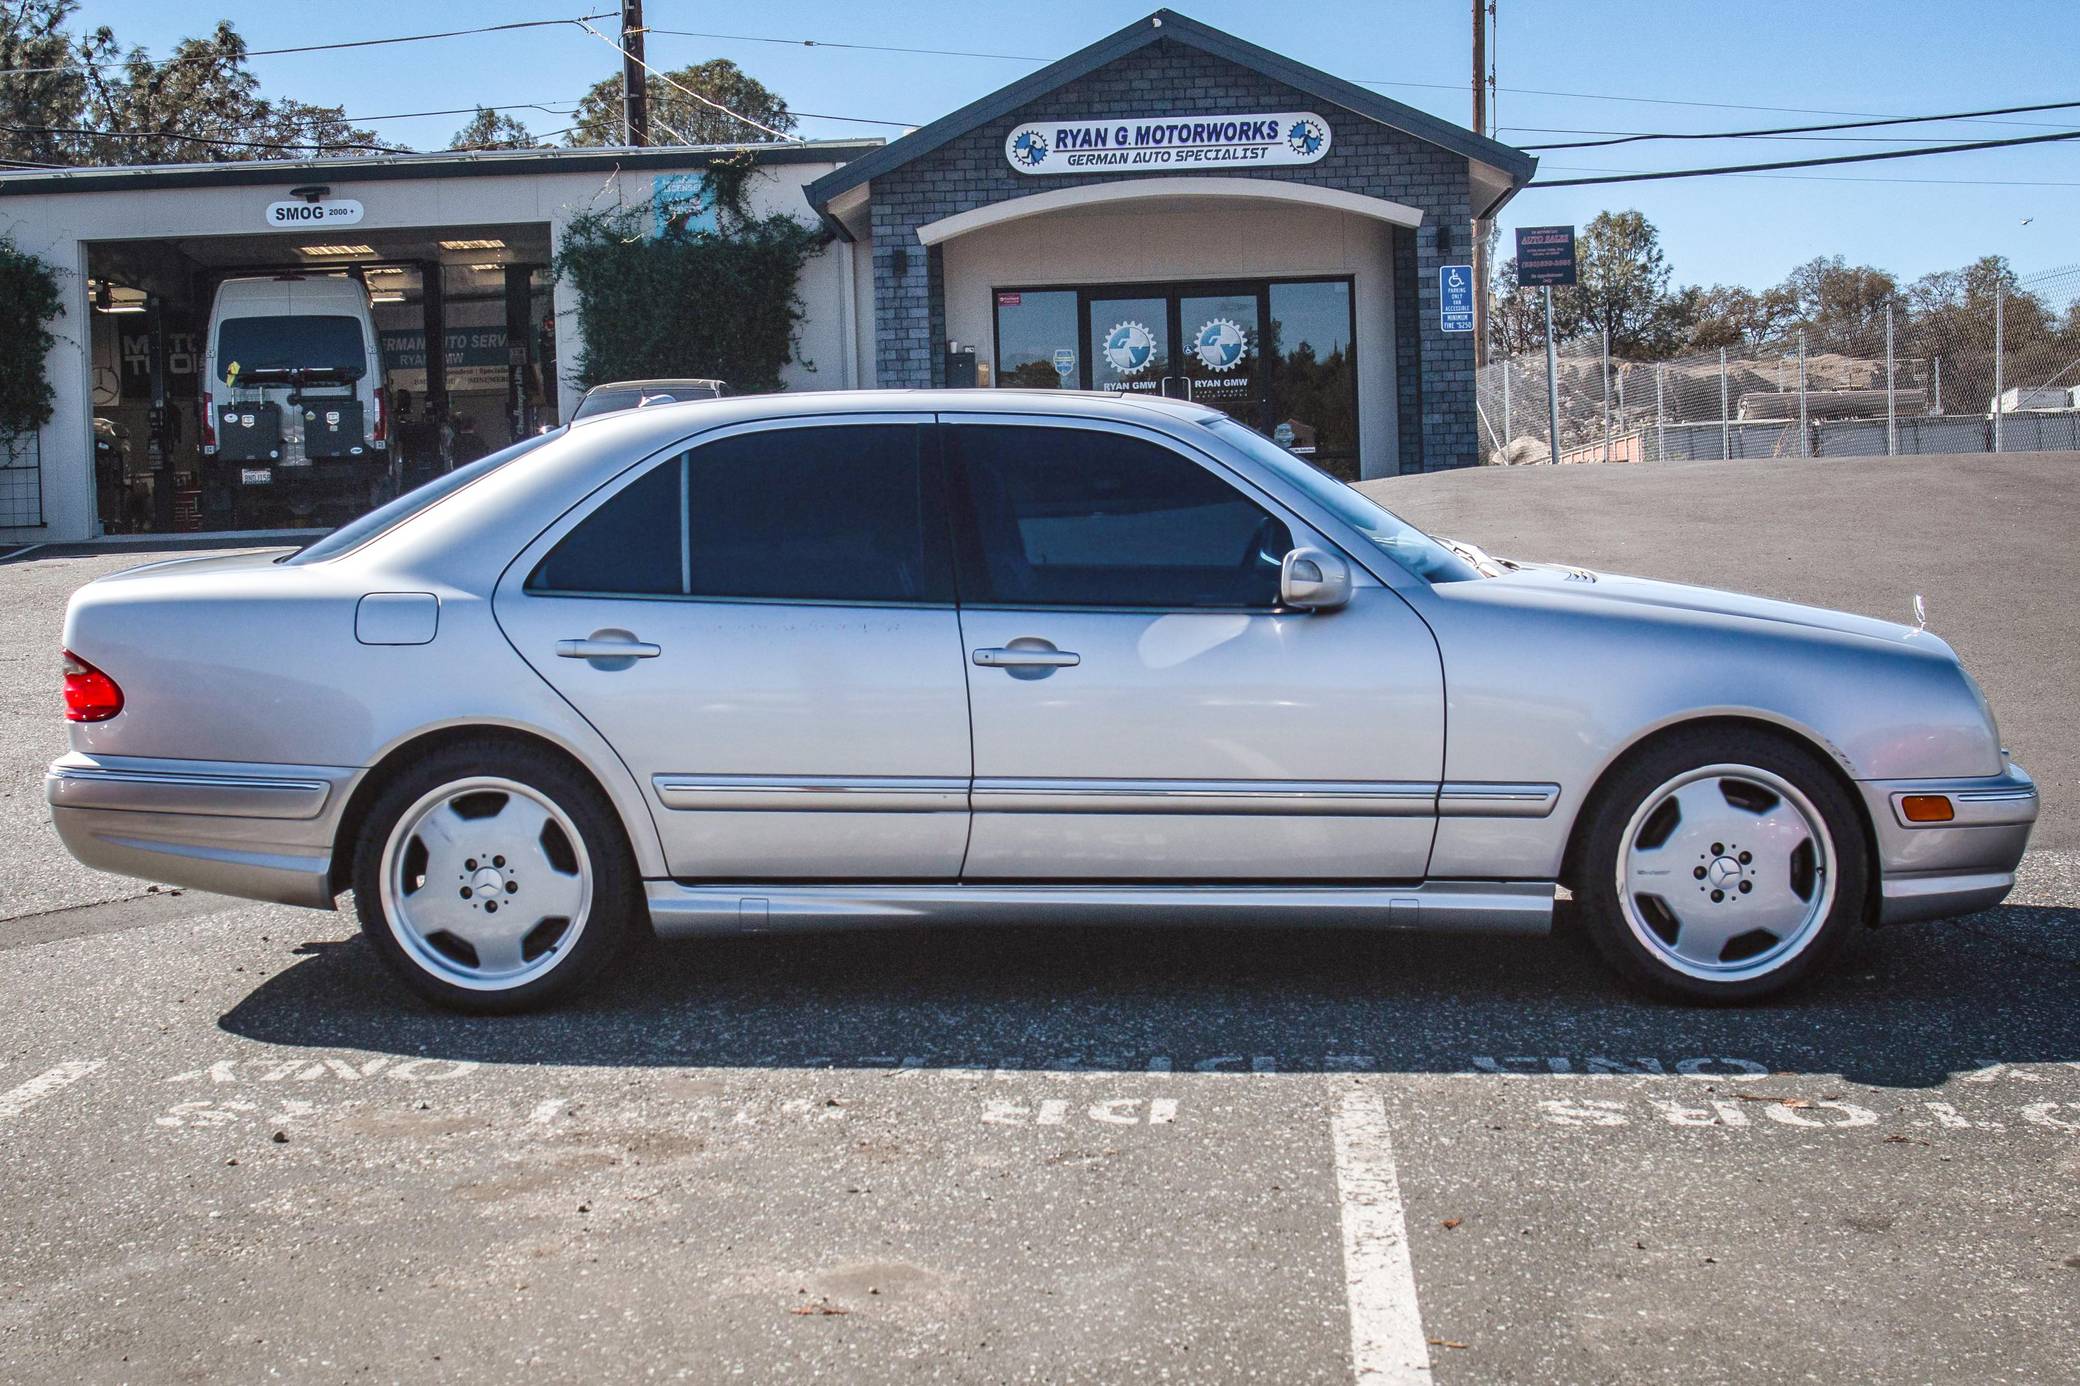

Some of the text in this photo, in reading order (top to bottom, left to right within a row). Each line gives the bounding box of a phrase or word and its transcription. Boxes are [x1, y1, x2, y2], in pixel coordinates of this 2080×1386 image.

[1055, 120, 1279, 149] RYAN G. MOTORWORKS
[1068, 147, 1268, 166] GERMAN AUTO SPECIALIST
[275, 206, 324, 221] SMOG
[329, 208, 348, 216] 2000
[1103, 381, 1156, 391] RYAN GMW
[1195, 378, 1248, 388] RYAN GMW
